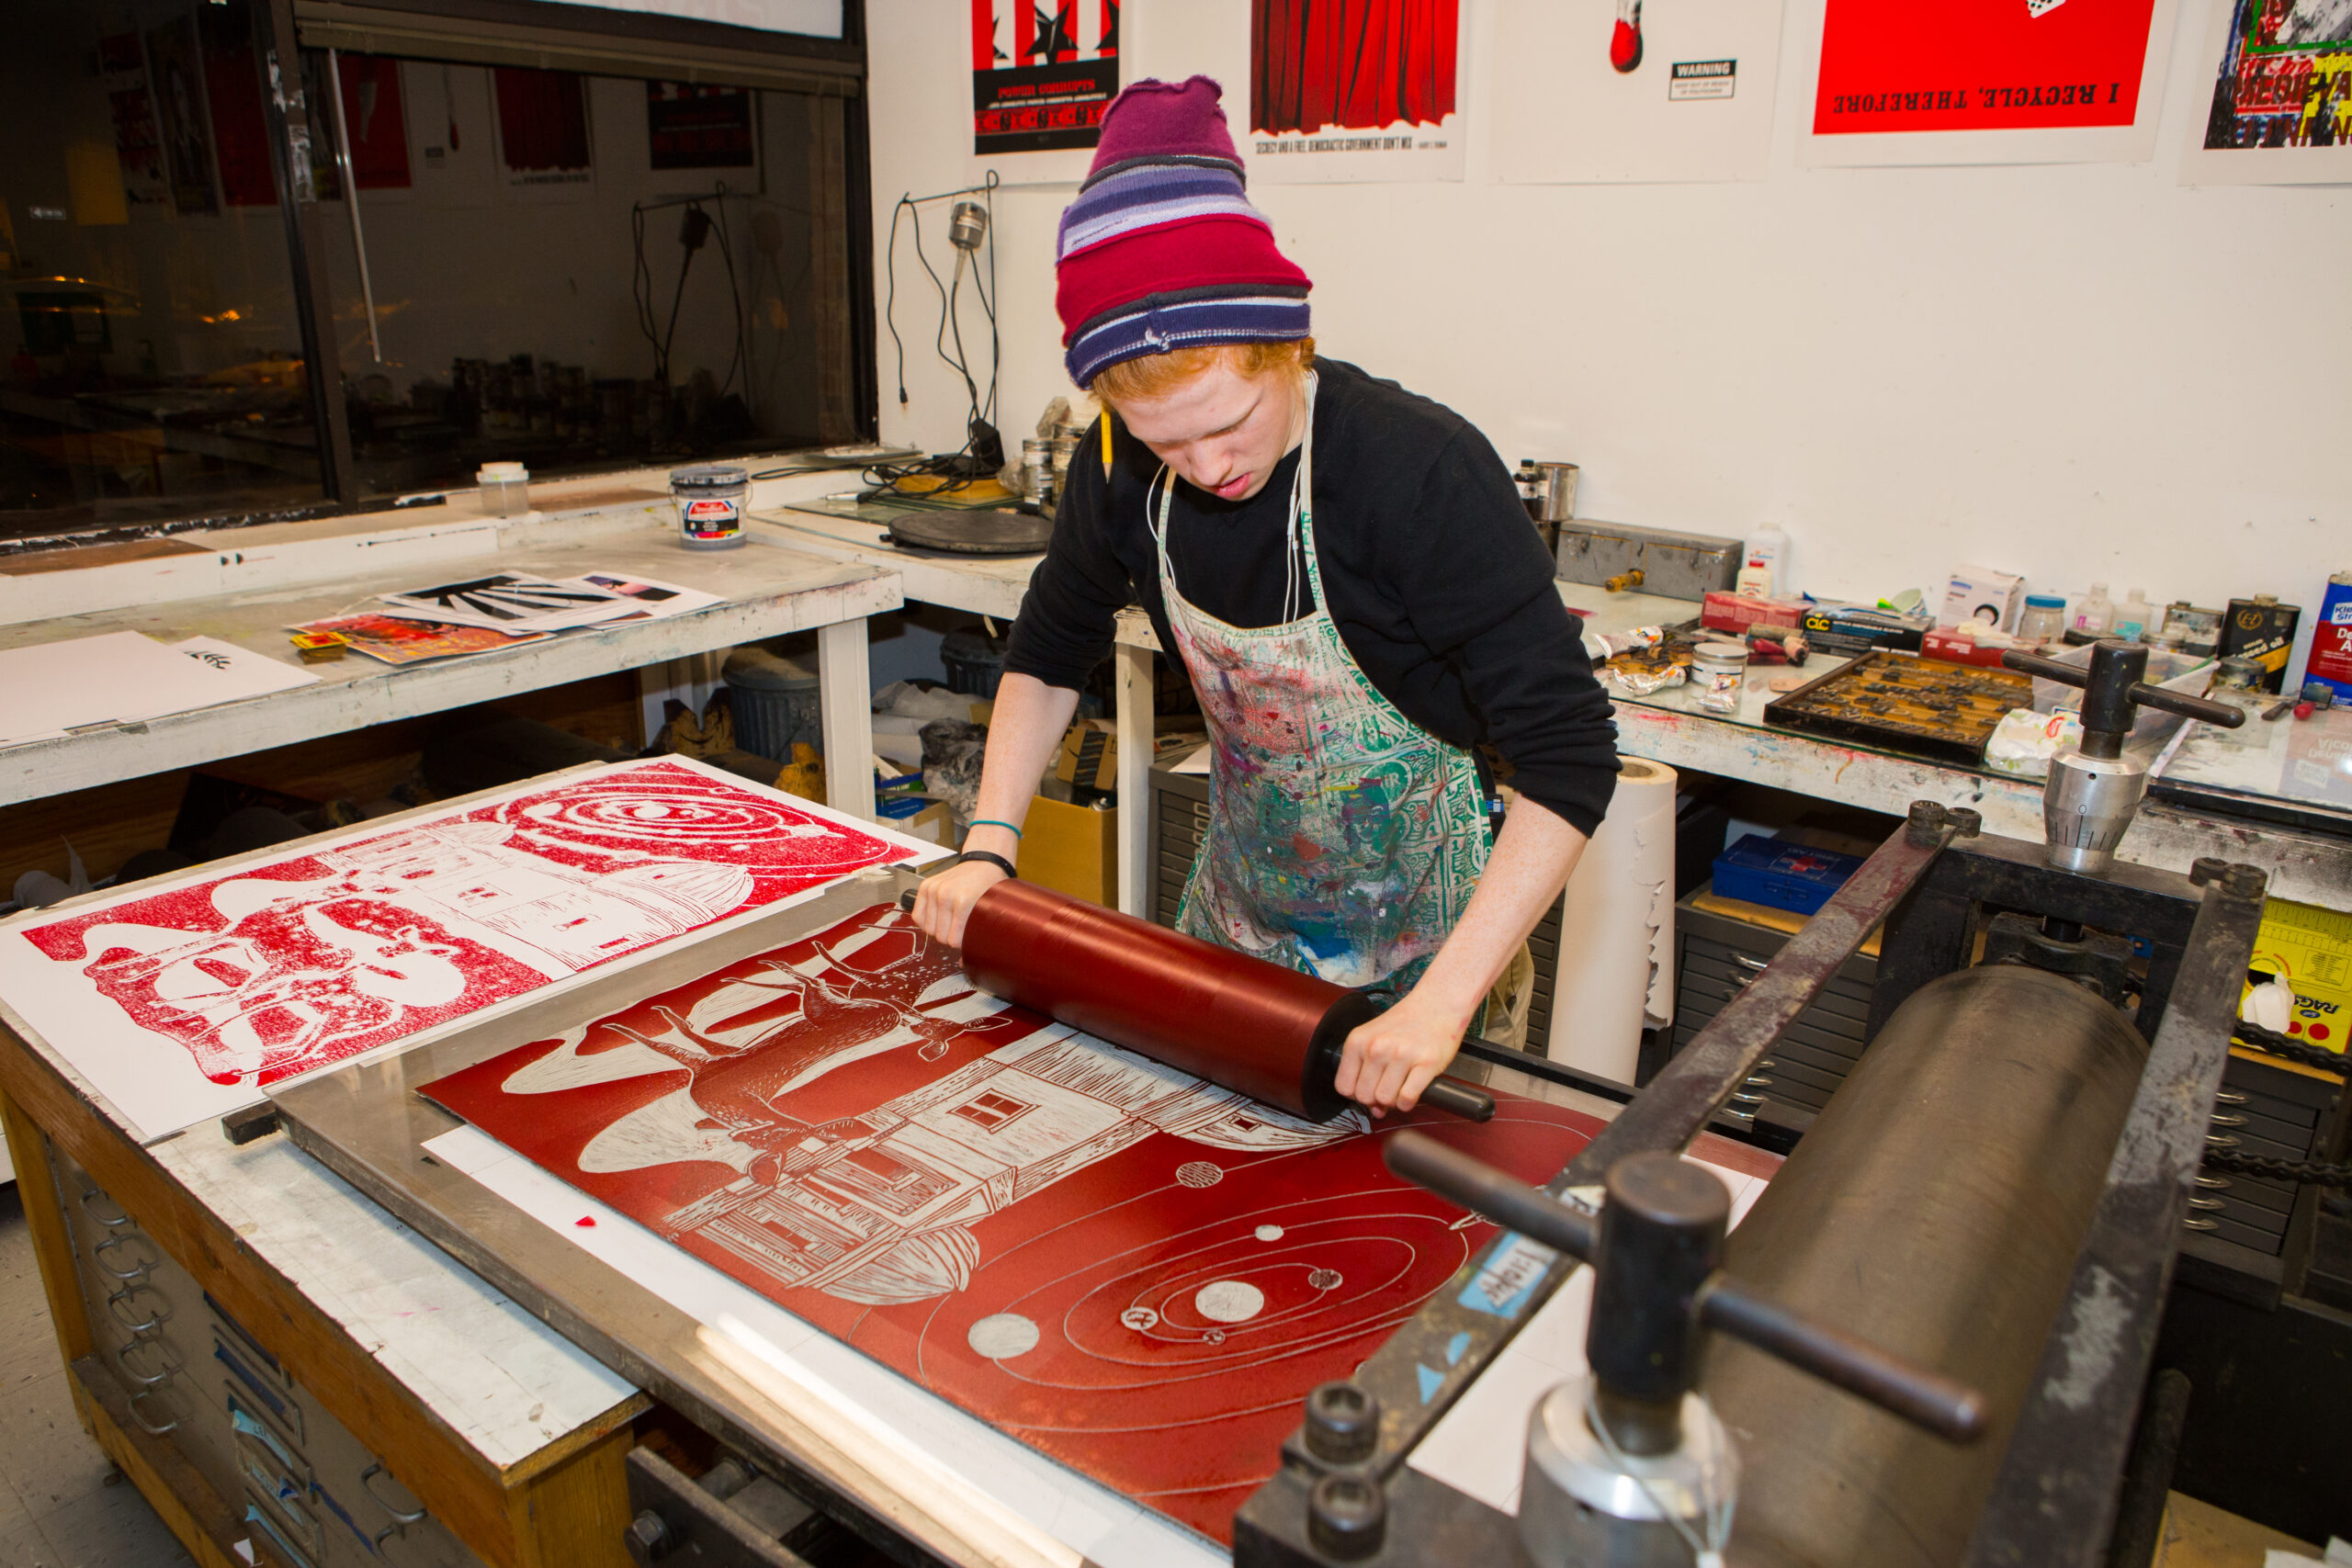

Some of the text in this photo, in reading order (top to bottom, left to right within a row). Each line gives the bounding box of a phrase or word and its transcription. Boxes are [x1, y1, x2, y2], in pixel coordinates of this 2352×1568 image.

[1677, 62, 1730, 77] WARNING
[998, 79, 1095, 99] POWER CORRUPTS
[1833, 83, 2120, 114] I RECYCLE, THEREFORE
[1256, 141, 1277, 154] SECRECY
[1345, 138, 1382, 152] GOVERNMENT
[1806, 617, 1830, 631] CLC
[2270, 636, 2285, 649] oil
